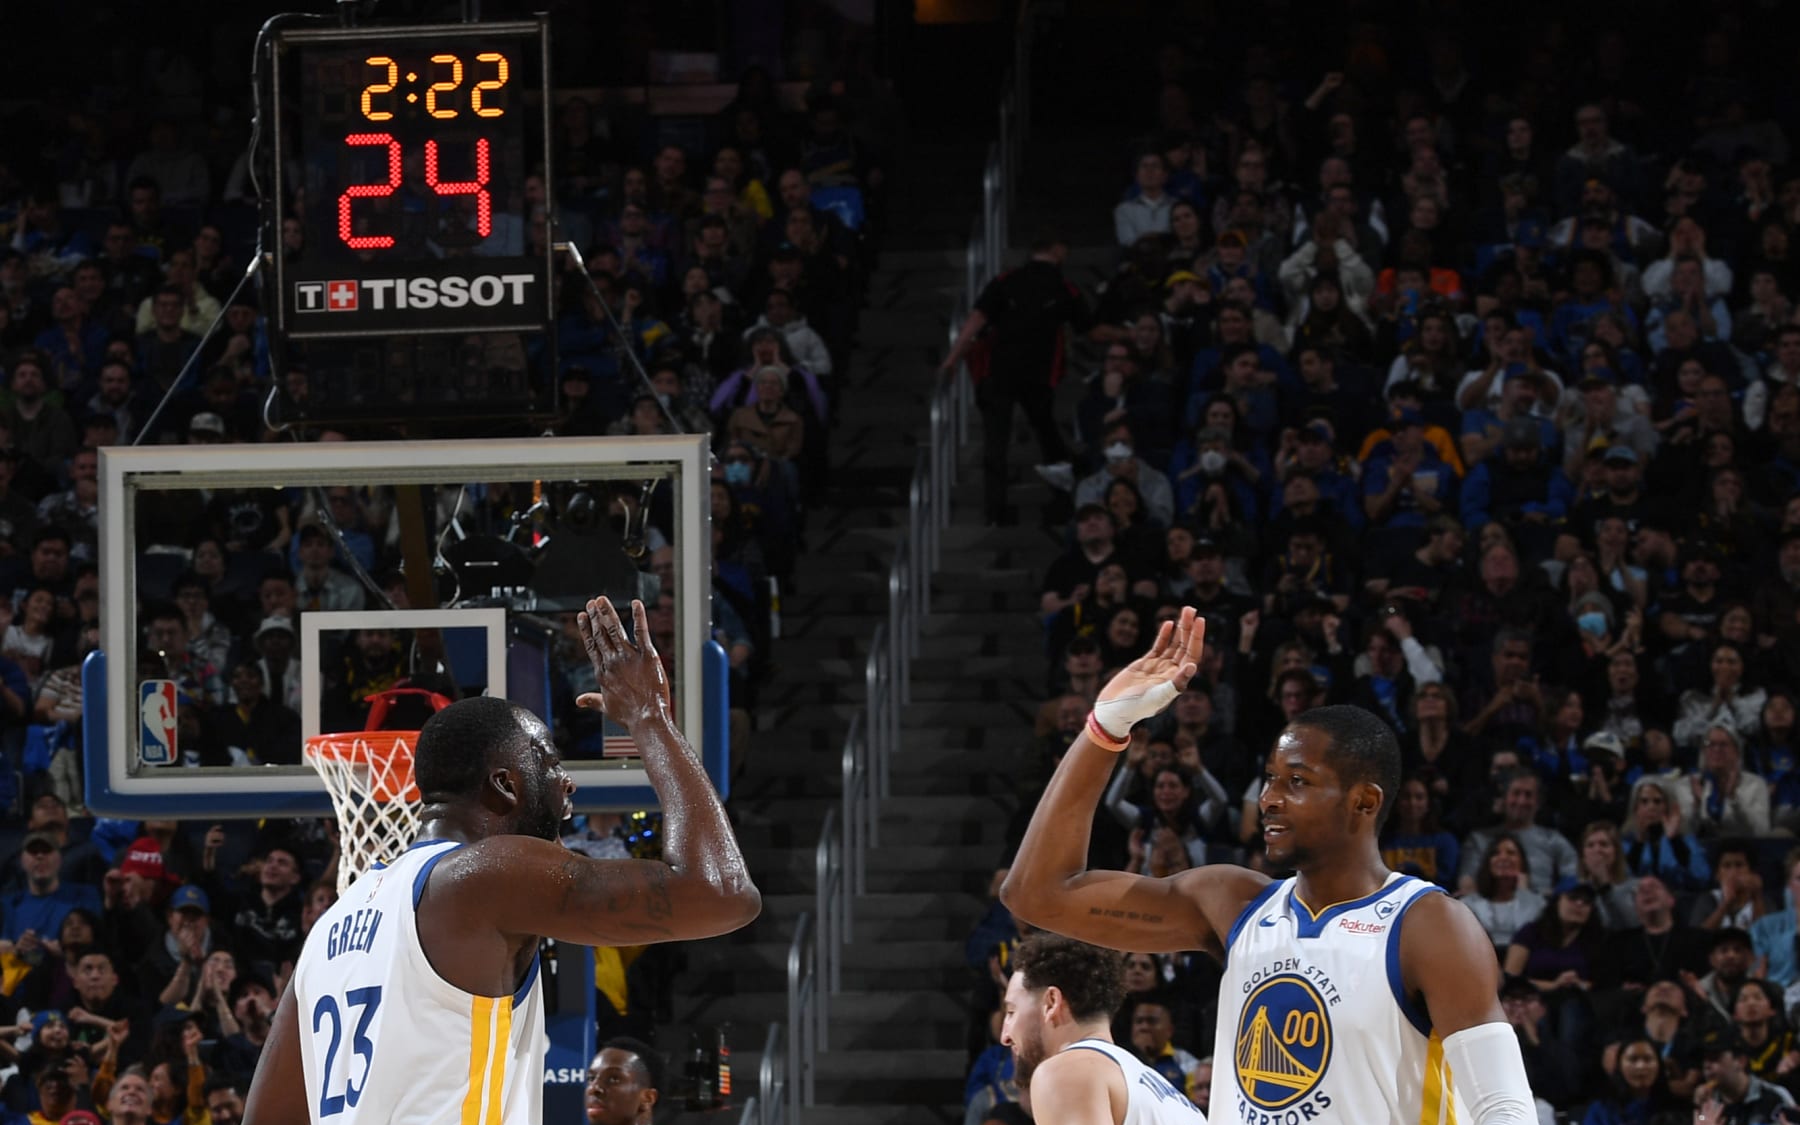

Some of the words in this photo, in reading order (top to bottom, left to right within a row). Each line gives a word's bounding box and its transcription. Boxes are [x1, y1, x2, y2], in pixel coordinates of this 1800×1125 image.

[361, 53, 509, 121] 2:22
[338, 133, 492, 249] 24
[299, 285, 323, 309] T
[361, 274, 535, 310] TISSOT
[327, 908, 383, 961] GREEN
[1338, 918, 1387, 934] Rakuten
[1242, 957, 1302, 995] GOLDEN
[1303, 964, 1342, 1007] STATE
[313, 985, 383, 1119] 23
[1282, 1008, 1320, 1048] 00
[543, 1067, 586, 1084] ASH
